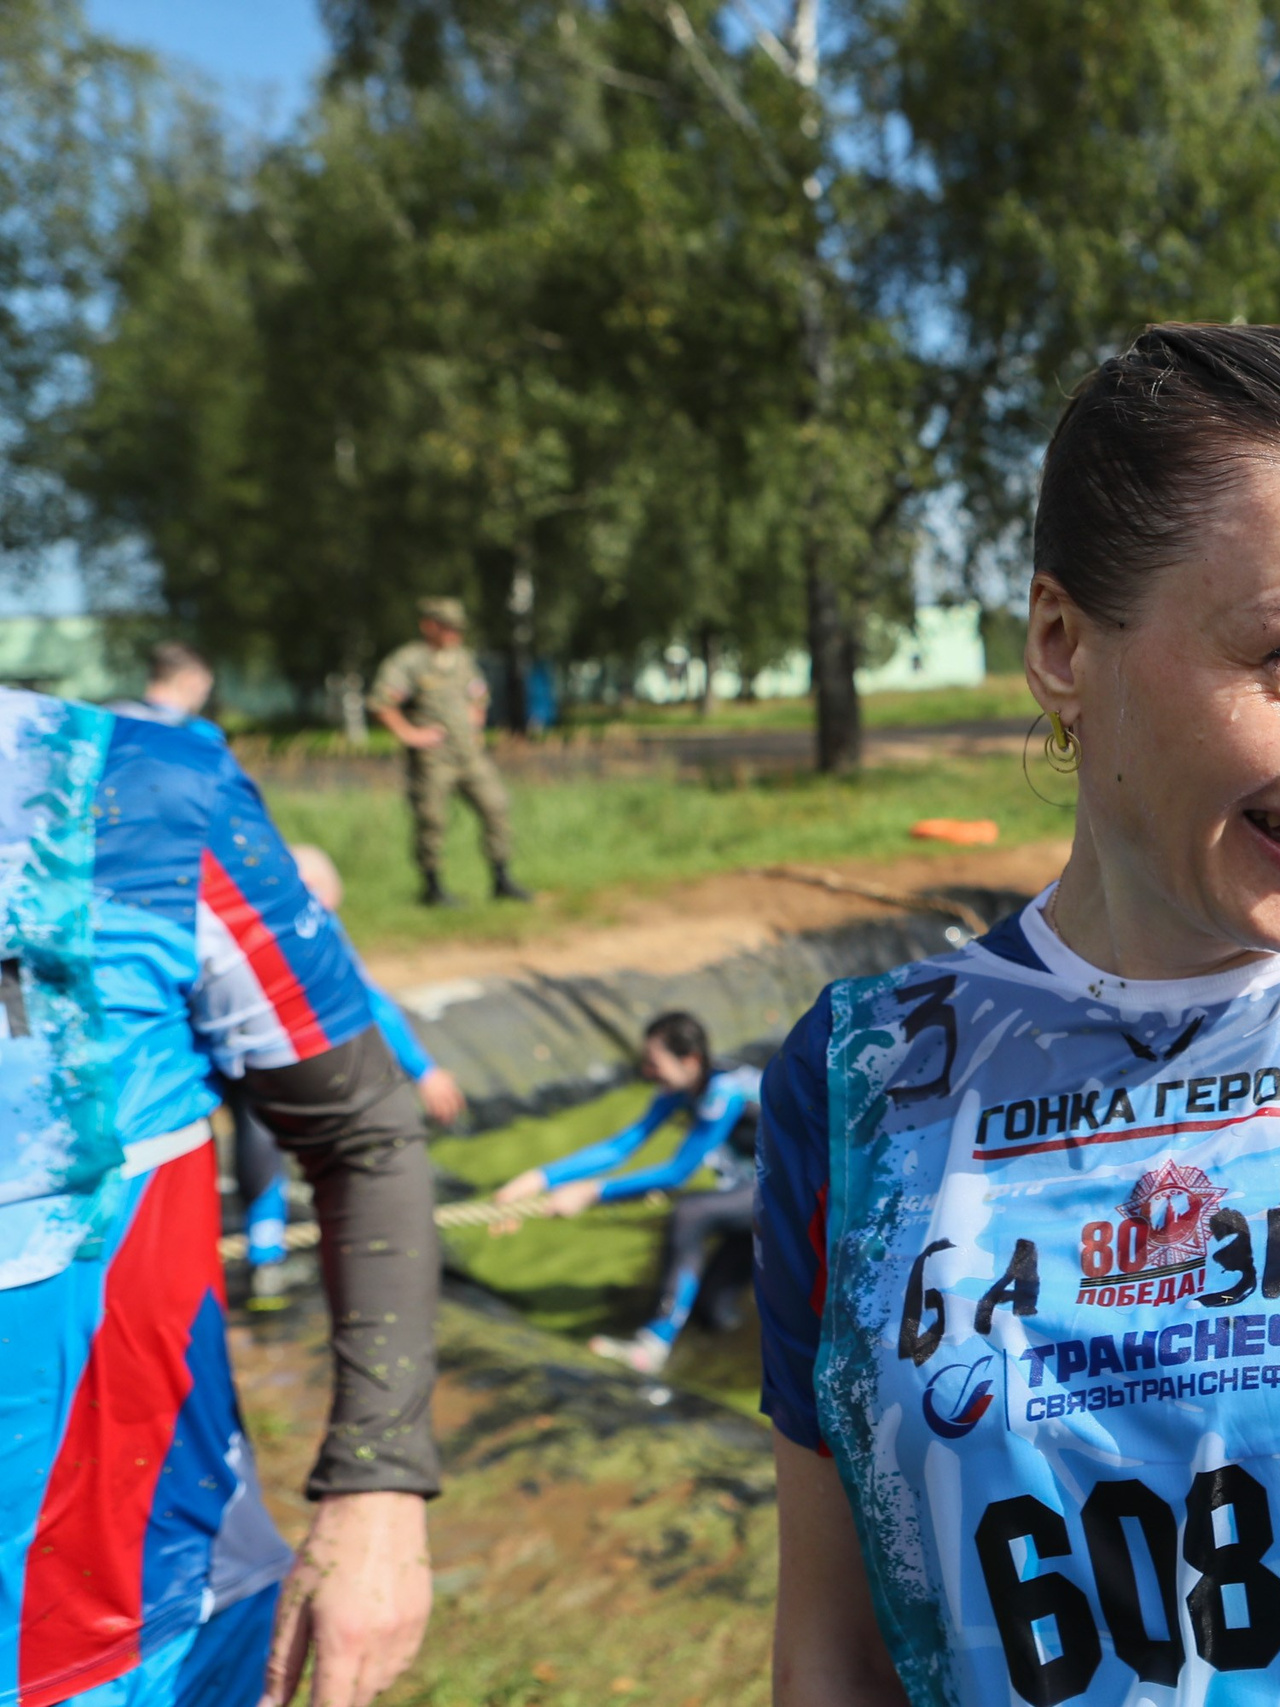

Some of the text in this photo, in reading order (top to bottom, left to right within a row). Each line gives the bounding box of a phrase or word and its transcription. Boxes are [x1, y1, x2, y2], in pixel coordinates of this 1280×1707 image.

[974, 1087, 1137, 1145] ГОНКА
[1080, 1216, 1150, 1278] 80
[1075, 1268, 1206, 1307] ПОБЕДА!
